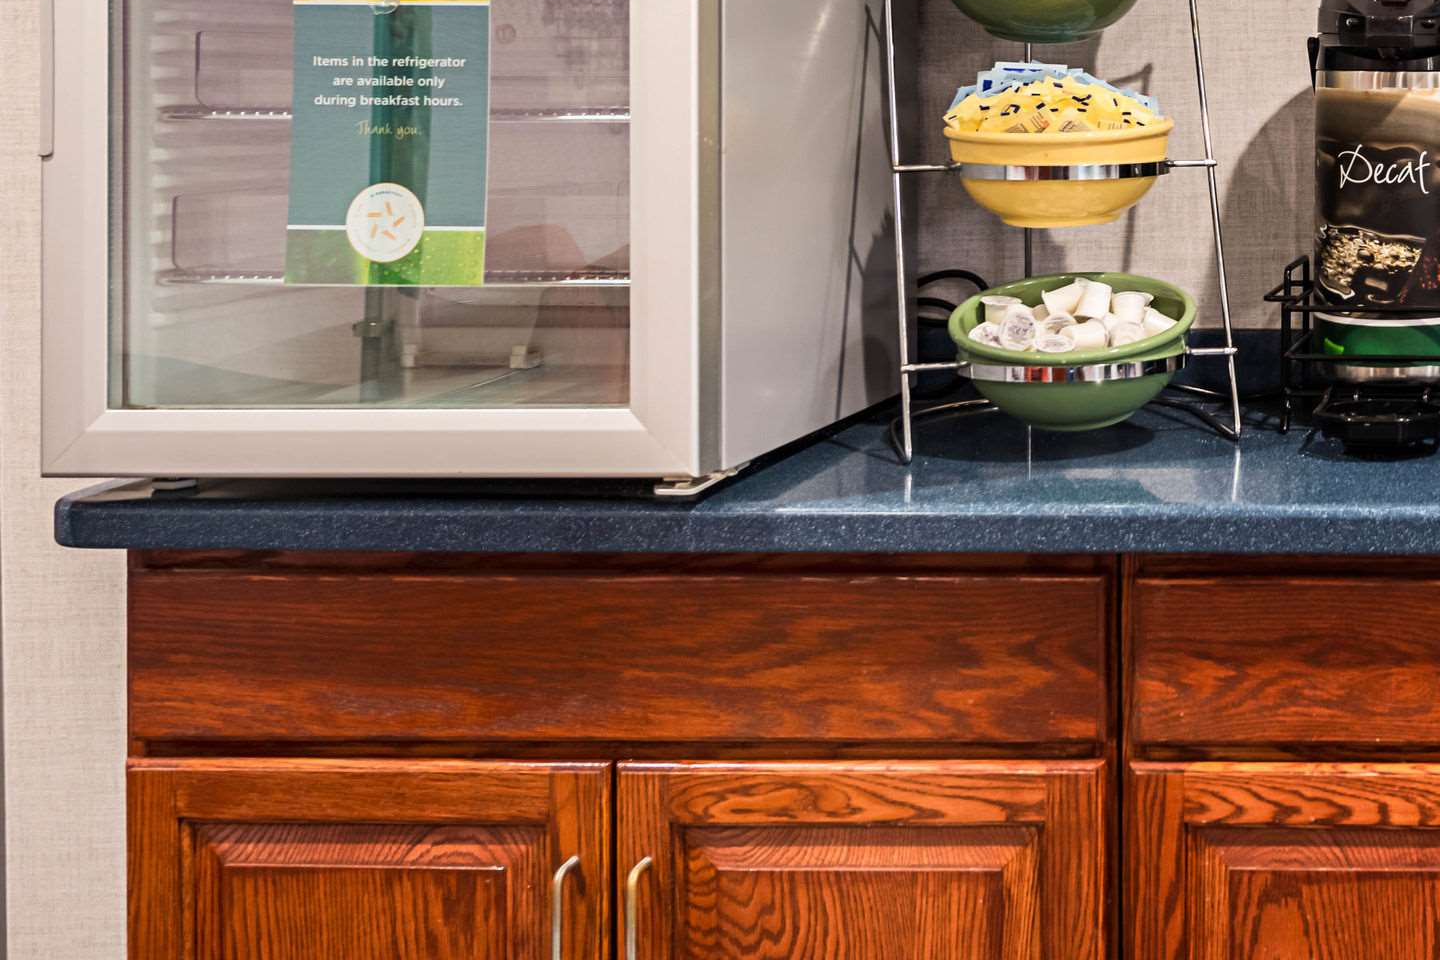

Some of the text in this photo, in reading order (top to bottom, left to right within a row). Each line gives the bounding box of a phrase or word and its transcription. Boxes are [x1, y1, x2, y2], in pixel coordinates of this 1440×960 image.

[313, 55, 467, 70] Items in the refrigerator
[333, 76, 446, 89] are available only
[314, 95, 463, 107] during breakfast hours.
[354, 119, 393, 136] Thank
[1338, 143, 1431, 194] Decaf
